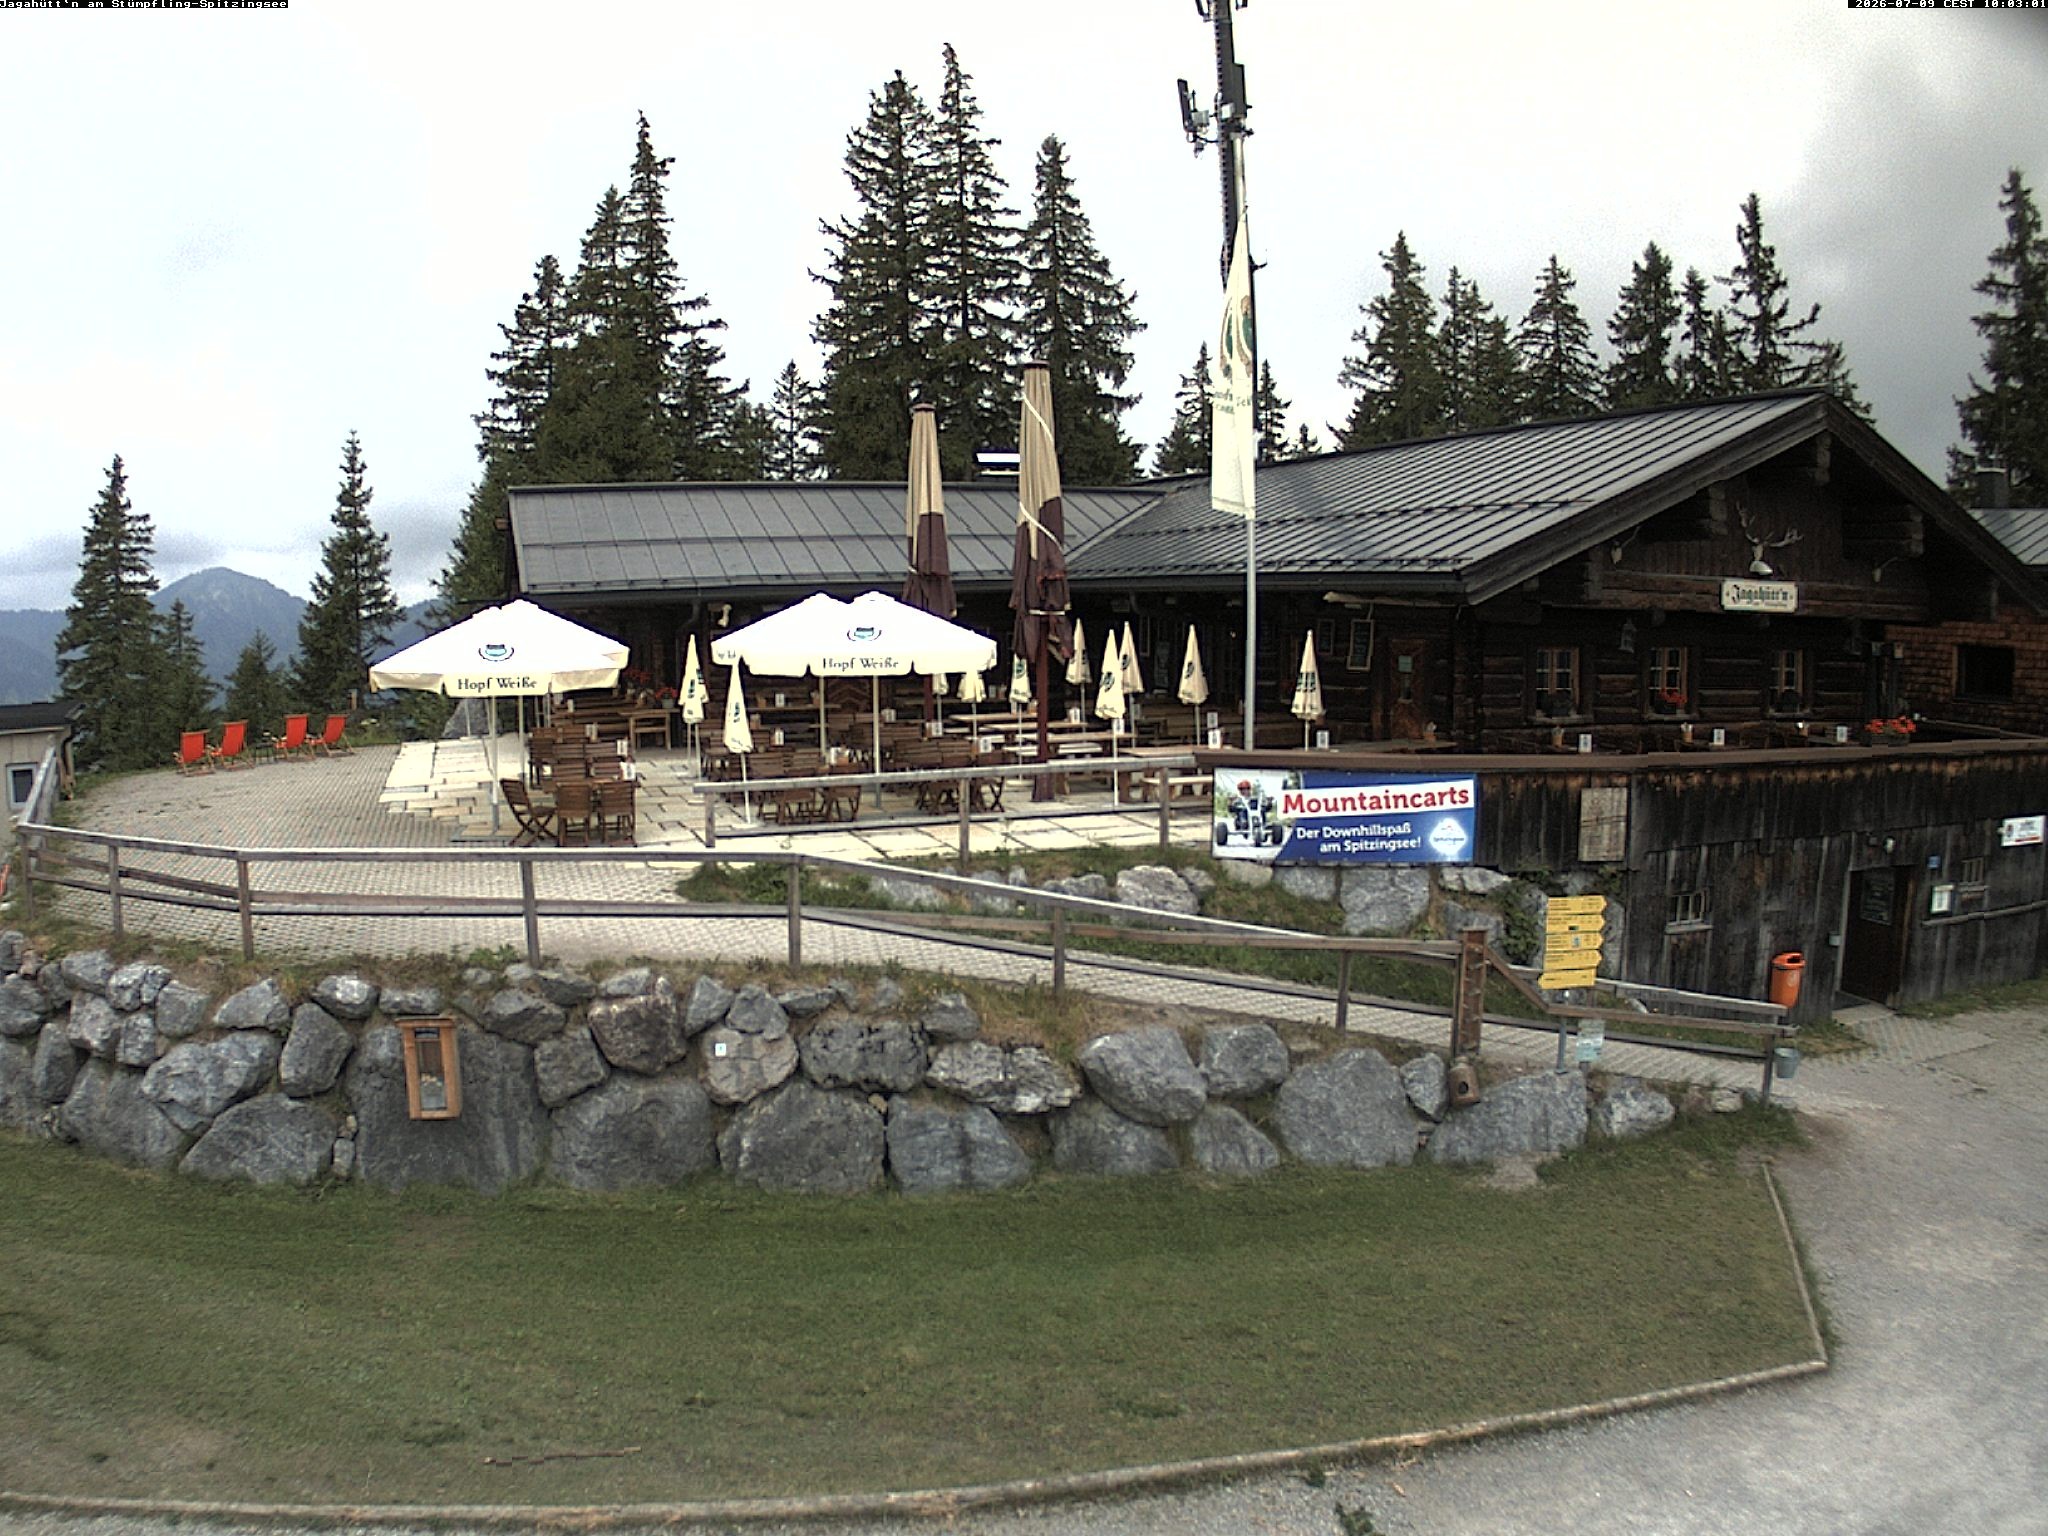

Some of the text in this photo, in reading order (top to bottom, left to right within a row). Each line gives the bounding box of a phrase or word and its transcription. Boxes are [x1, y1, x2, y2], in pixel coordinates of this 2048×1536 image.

[823, 657, 899, 672] Hopf Weiße
[458, 677, 537, 692] Hopf Weiße
[1282, 787, 1469, 814] Mountaincarts
[1296, 823, 1411, 839] Der Downhillspaß
[1320, 843, 1341, 852] am
[1344, 838, 1421, 853] Spitzingsee!
